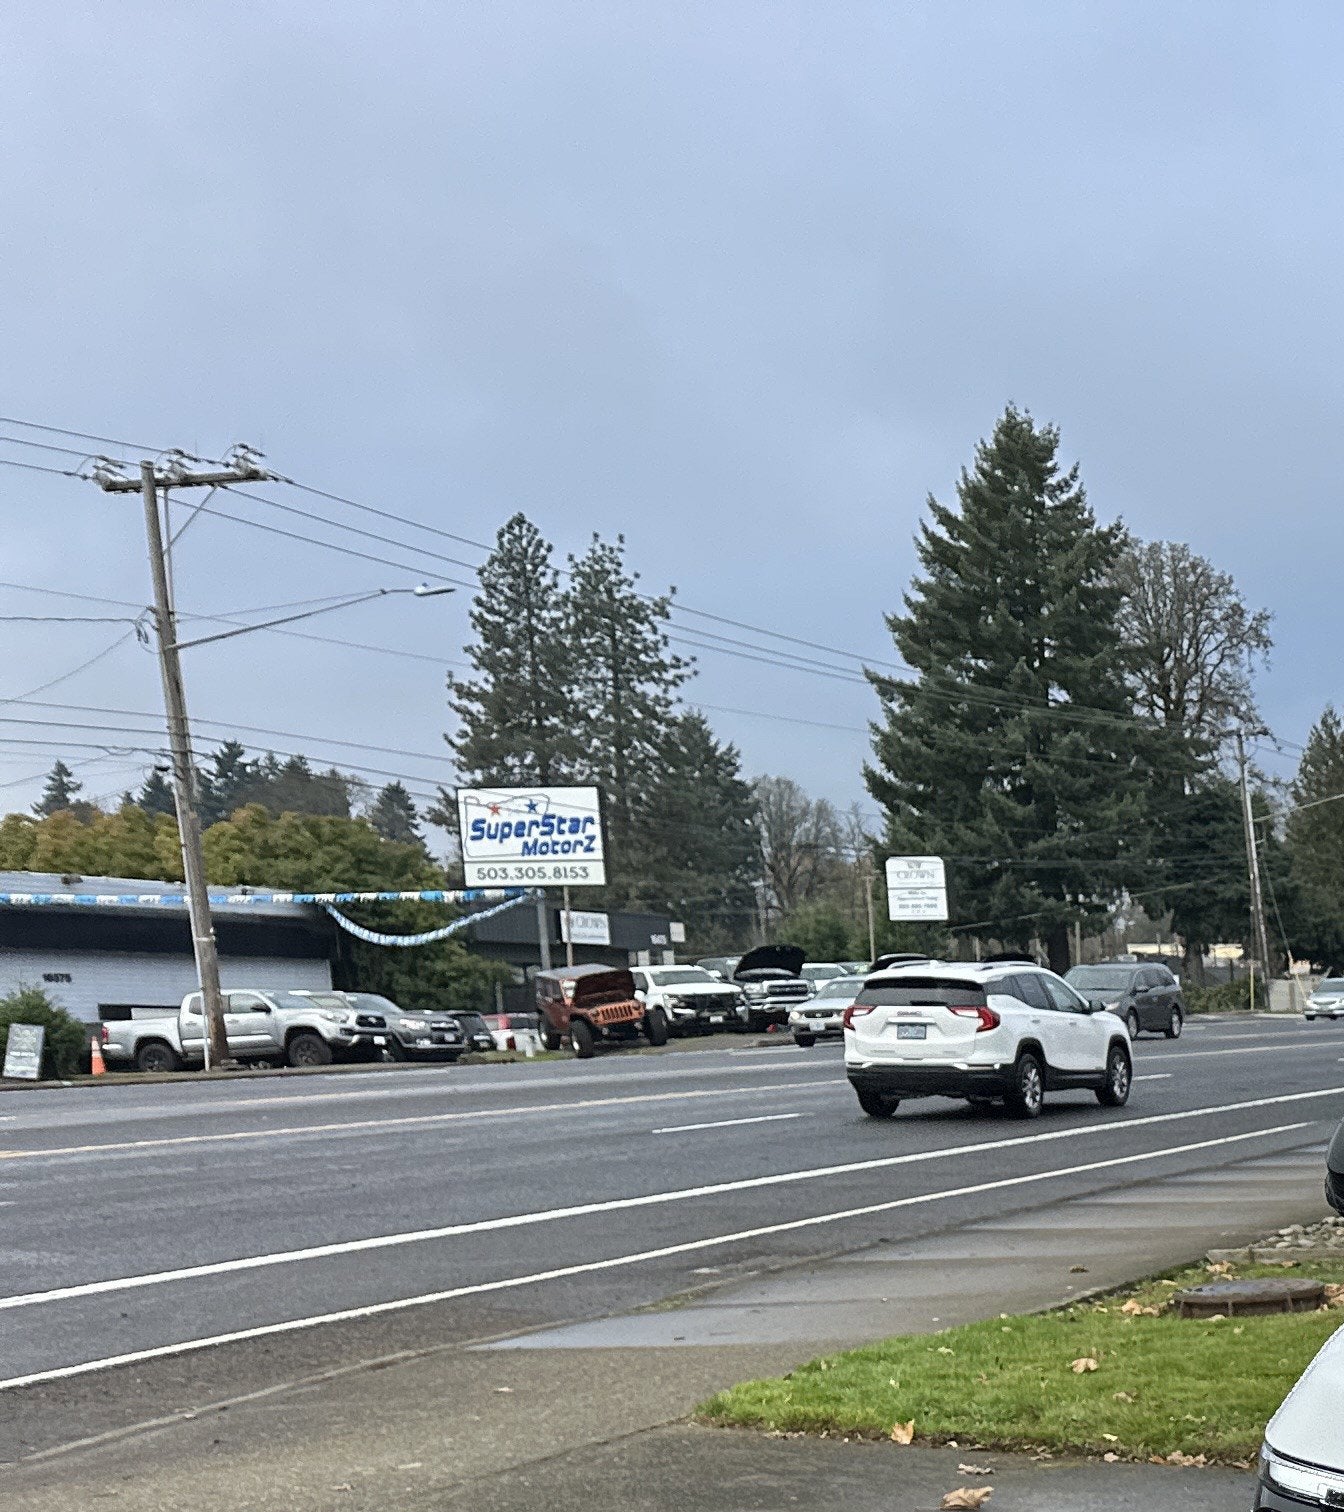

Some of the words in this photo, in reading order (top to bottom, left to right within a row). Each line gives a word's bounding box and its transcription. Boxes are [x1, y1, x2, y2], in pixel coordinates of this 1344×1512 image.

[470, 814, 595, 843] SuperStar
[521, 835, 597, 857] MotorZ
[476, 866, 590, 881] 503.305.8153
